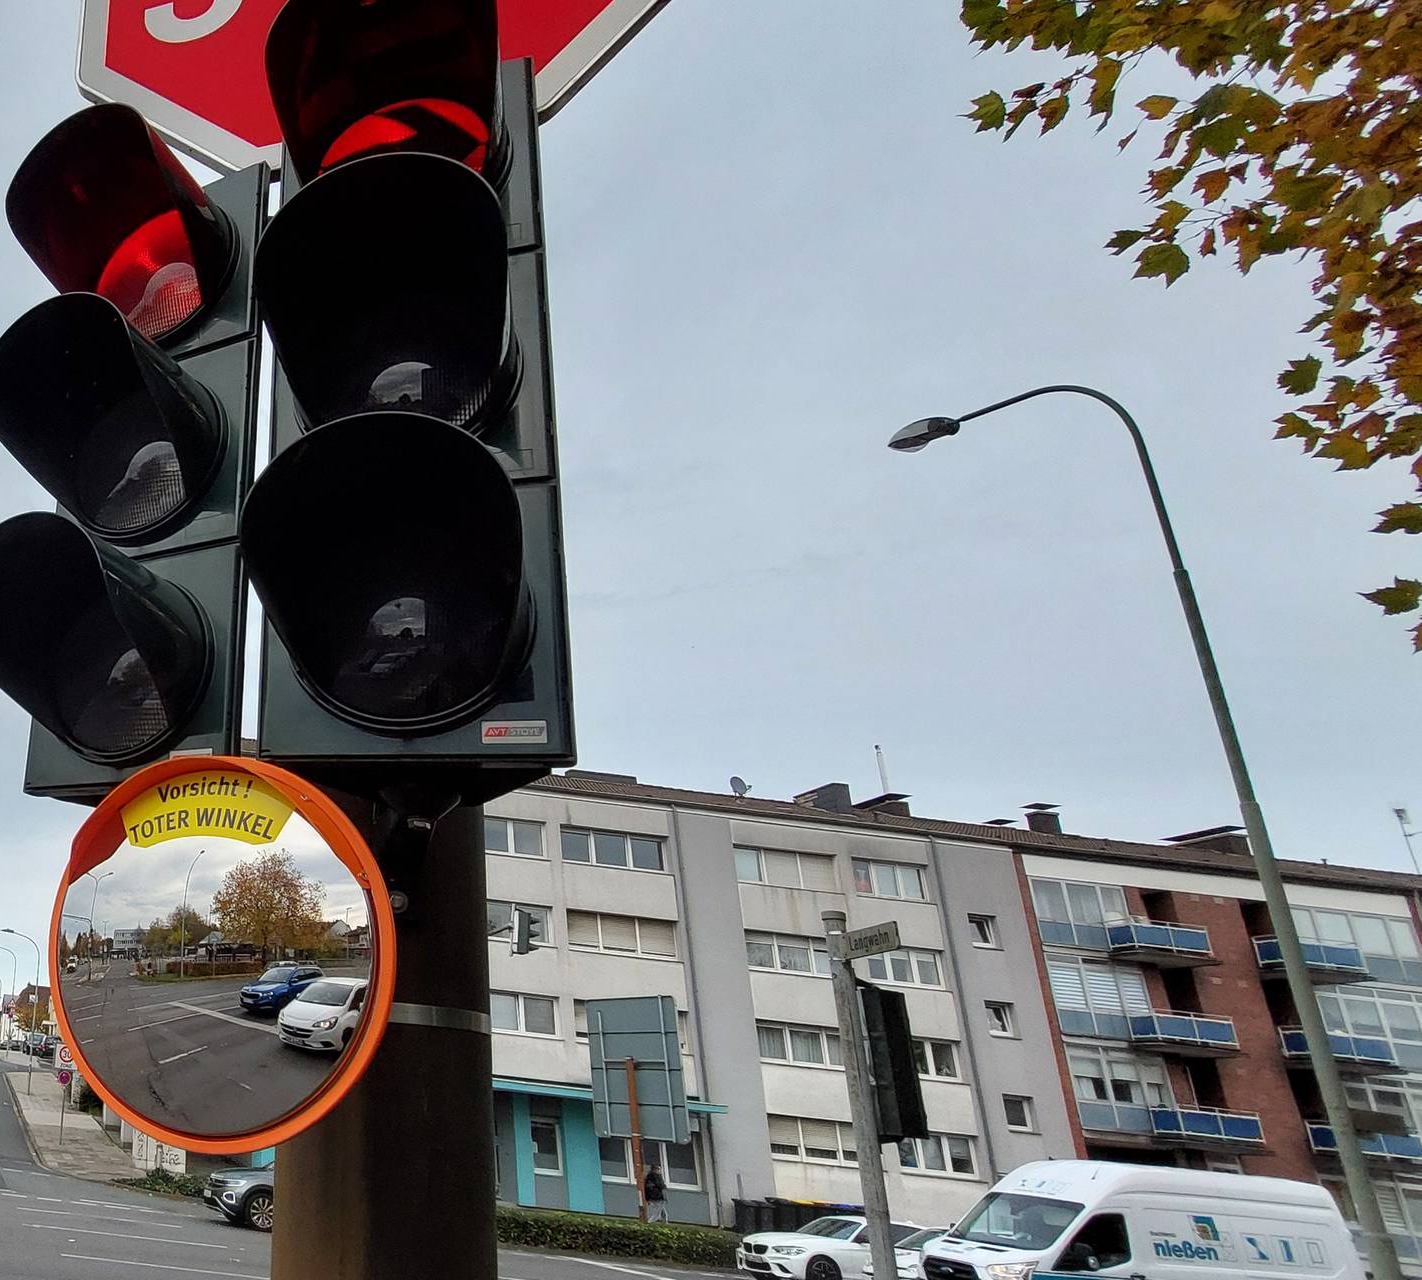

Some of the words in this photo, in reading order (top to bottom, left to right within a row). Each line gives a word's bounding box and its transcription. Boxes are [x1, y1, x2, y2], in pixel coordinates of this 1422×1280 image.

[157, 776, 240, 803] Vorsicht
[129, 809, 190, 844] TOTER
[196, 807, 274, 840] WINKEL
[848, 928, 890, 953] Langwahn
